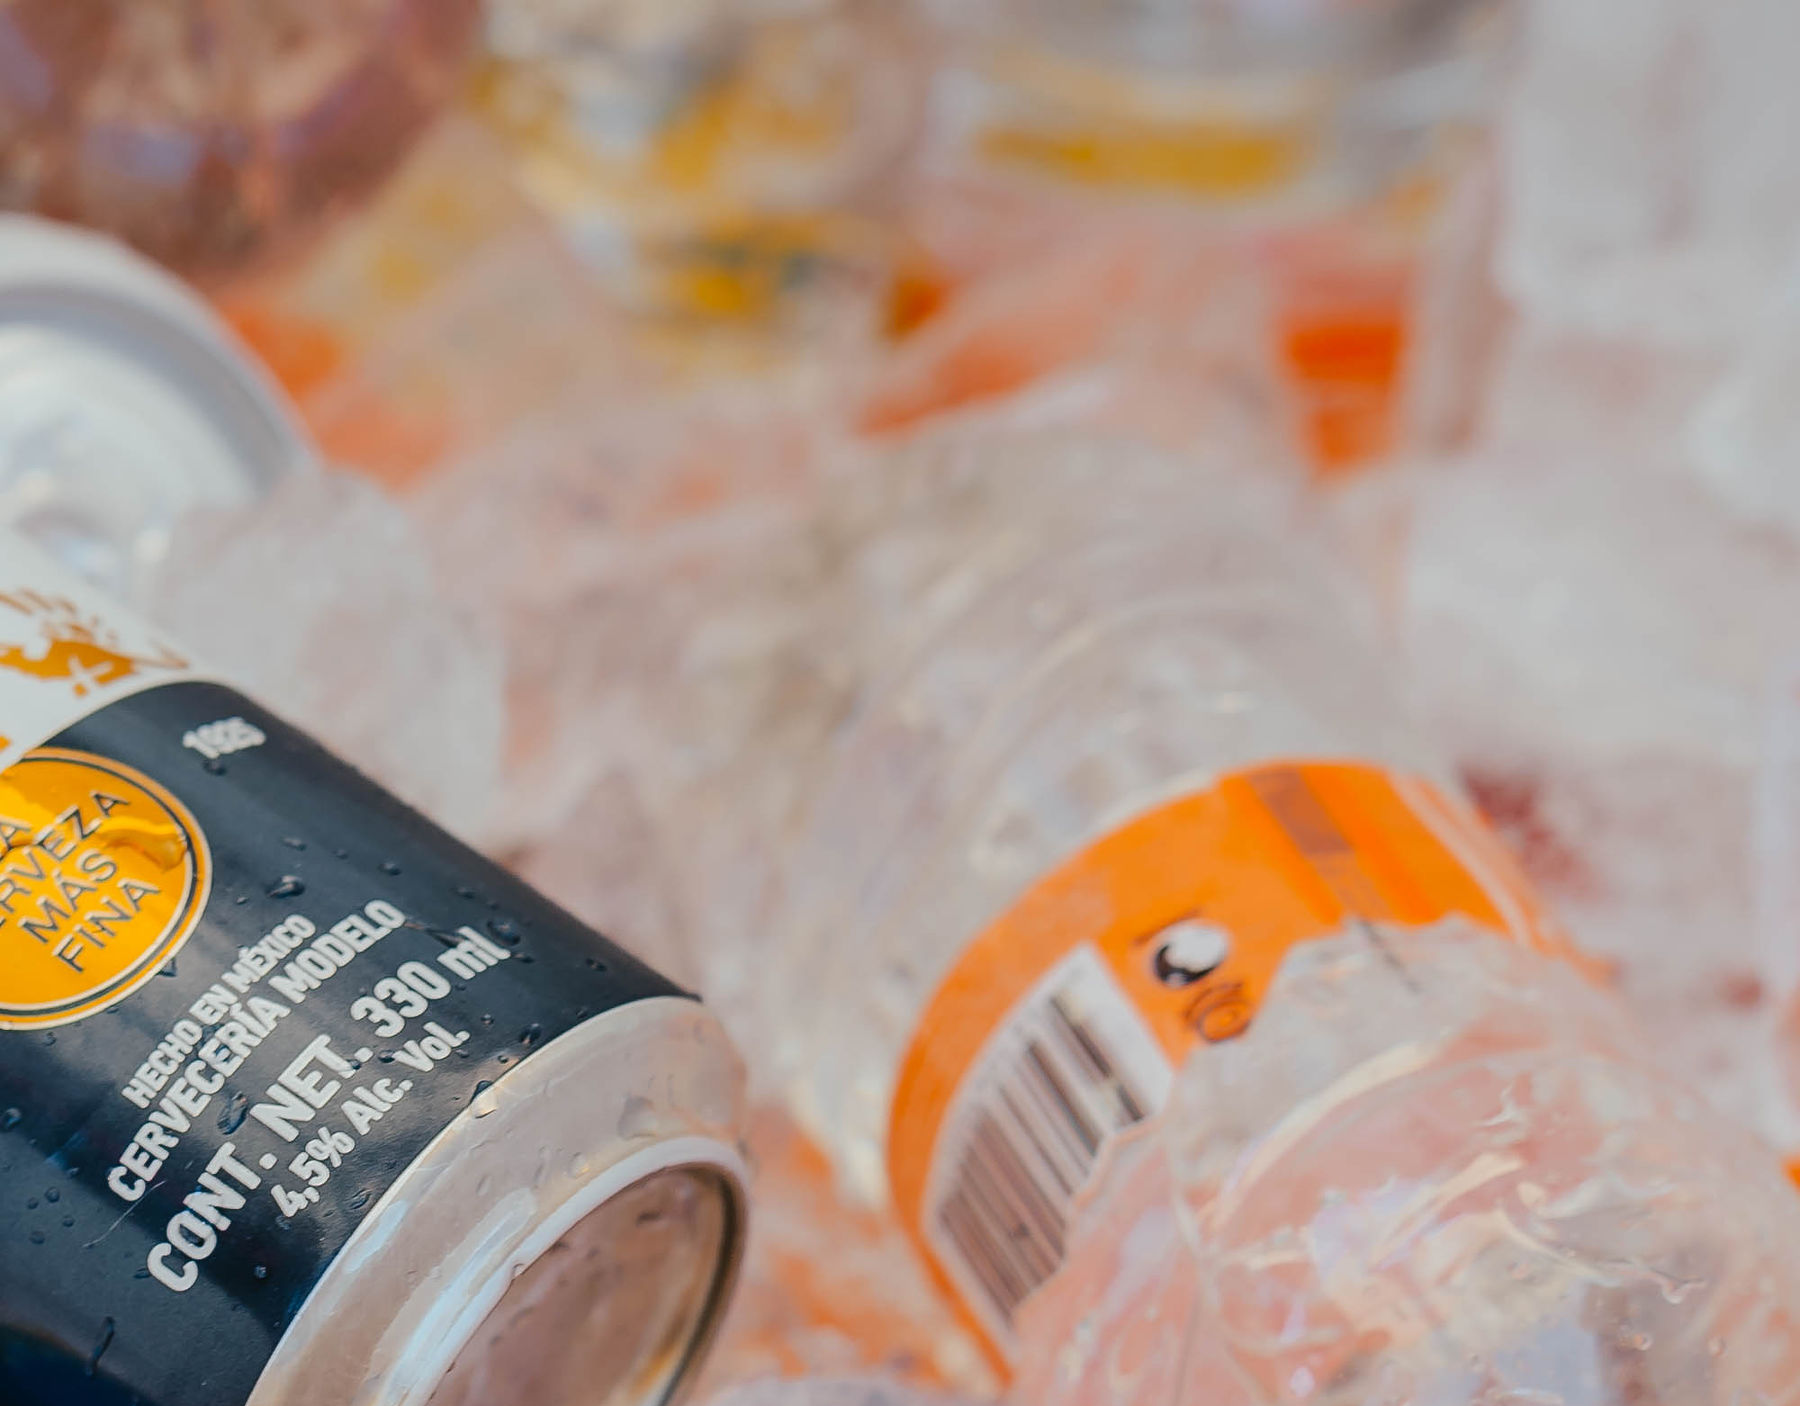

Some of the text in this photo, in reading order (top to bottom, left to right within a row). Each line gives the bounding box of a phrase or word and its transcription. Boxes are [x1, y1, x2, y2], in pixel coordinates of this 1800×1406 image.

[18, 849, 117, 943] MÁS
[52, 878, 161, 972] FINA
[108, 900, 406, 1201] CERVECERÍA MODELO
[122, 914, 317, 1109] HECHO EN MÉXICO
[147, 927, 510, 1292] CONT. NET. 330 ml
[271, 1022, 470, 1217] 4,5% Alc. Vol.
